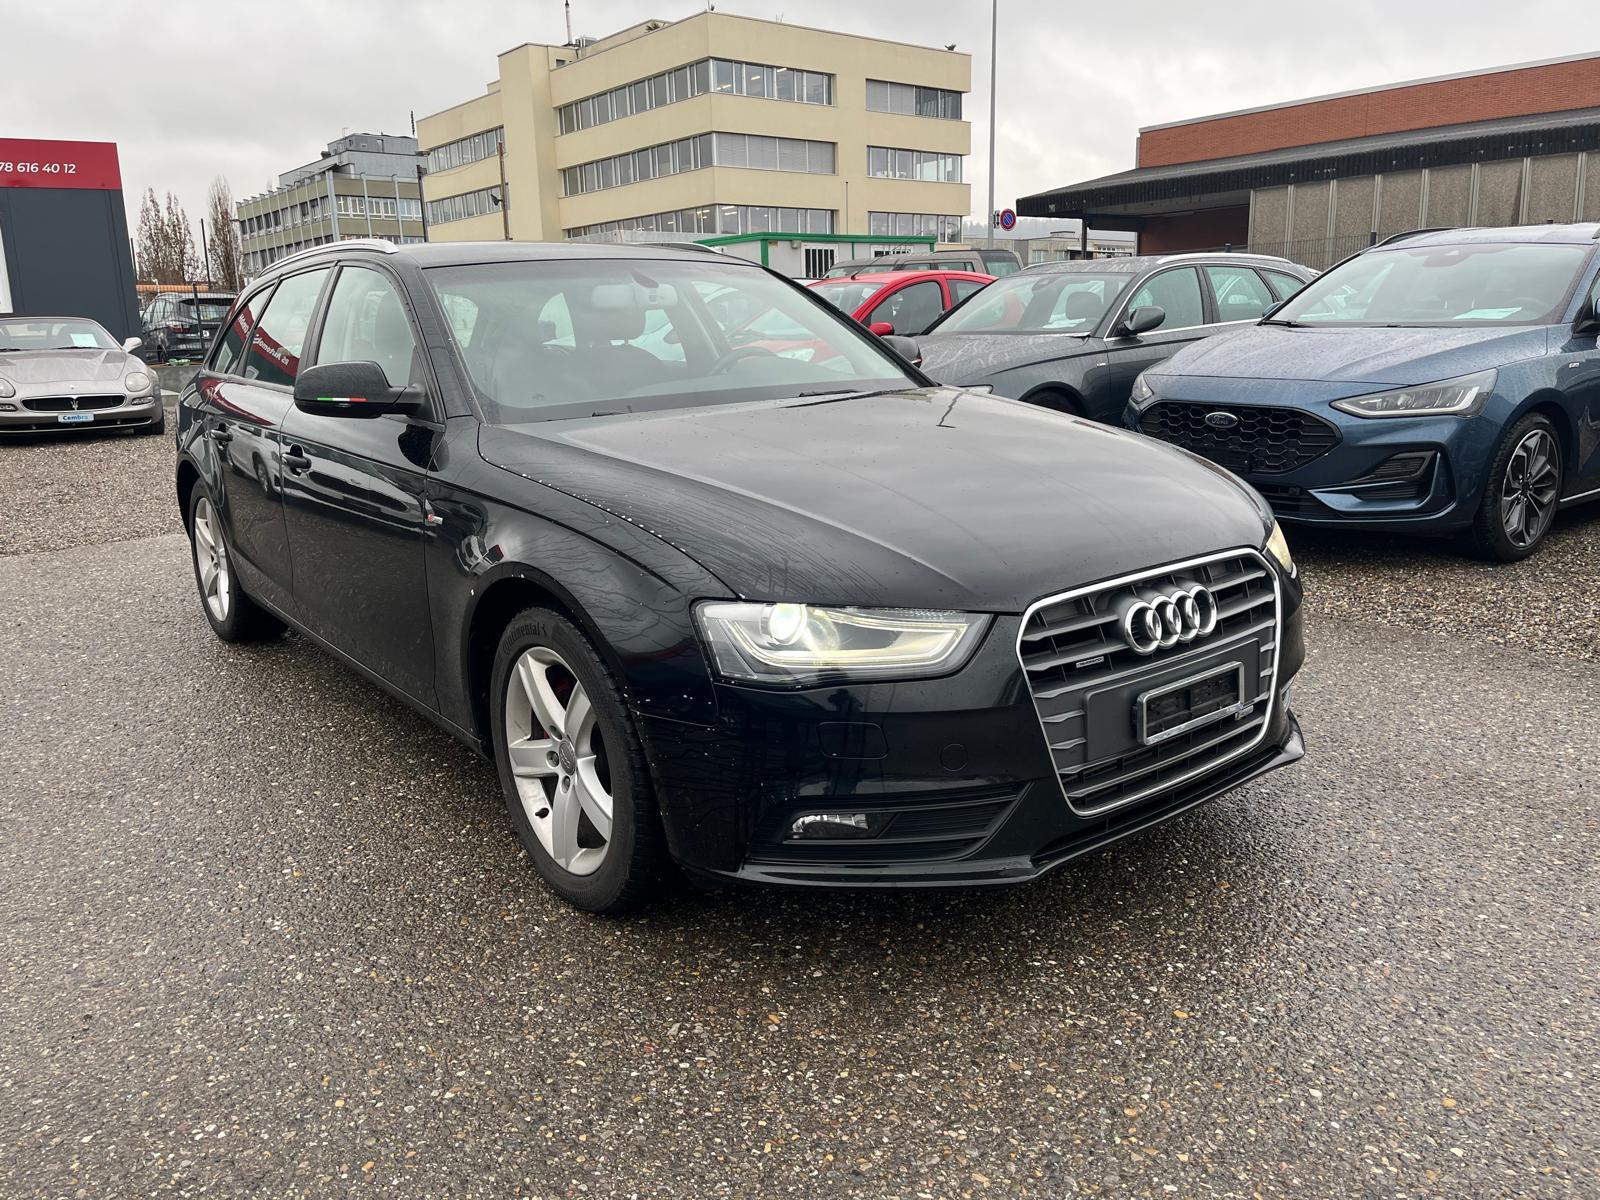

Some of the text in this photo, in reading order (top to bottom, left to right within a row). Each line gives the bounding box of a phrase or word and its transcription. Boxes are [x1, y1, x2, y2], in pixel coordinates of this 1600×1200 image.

[17, 162, 39, 173] 616
[42, 163, 60, 173] 40
[63, 163, 76, 174] 12
